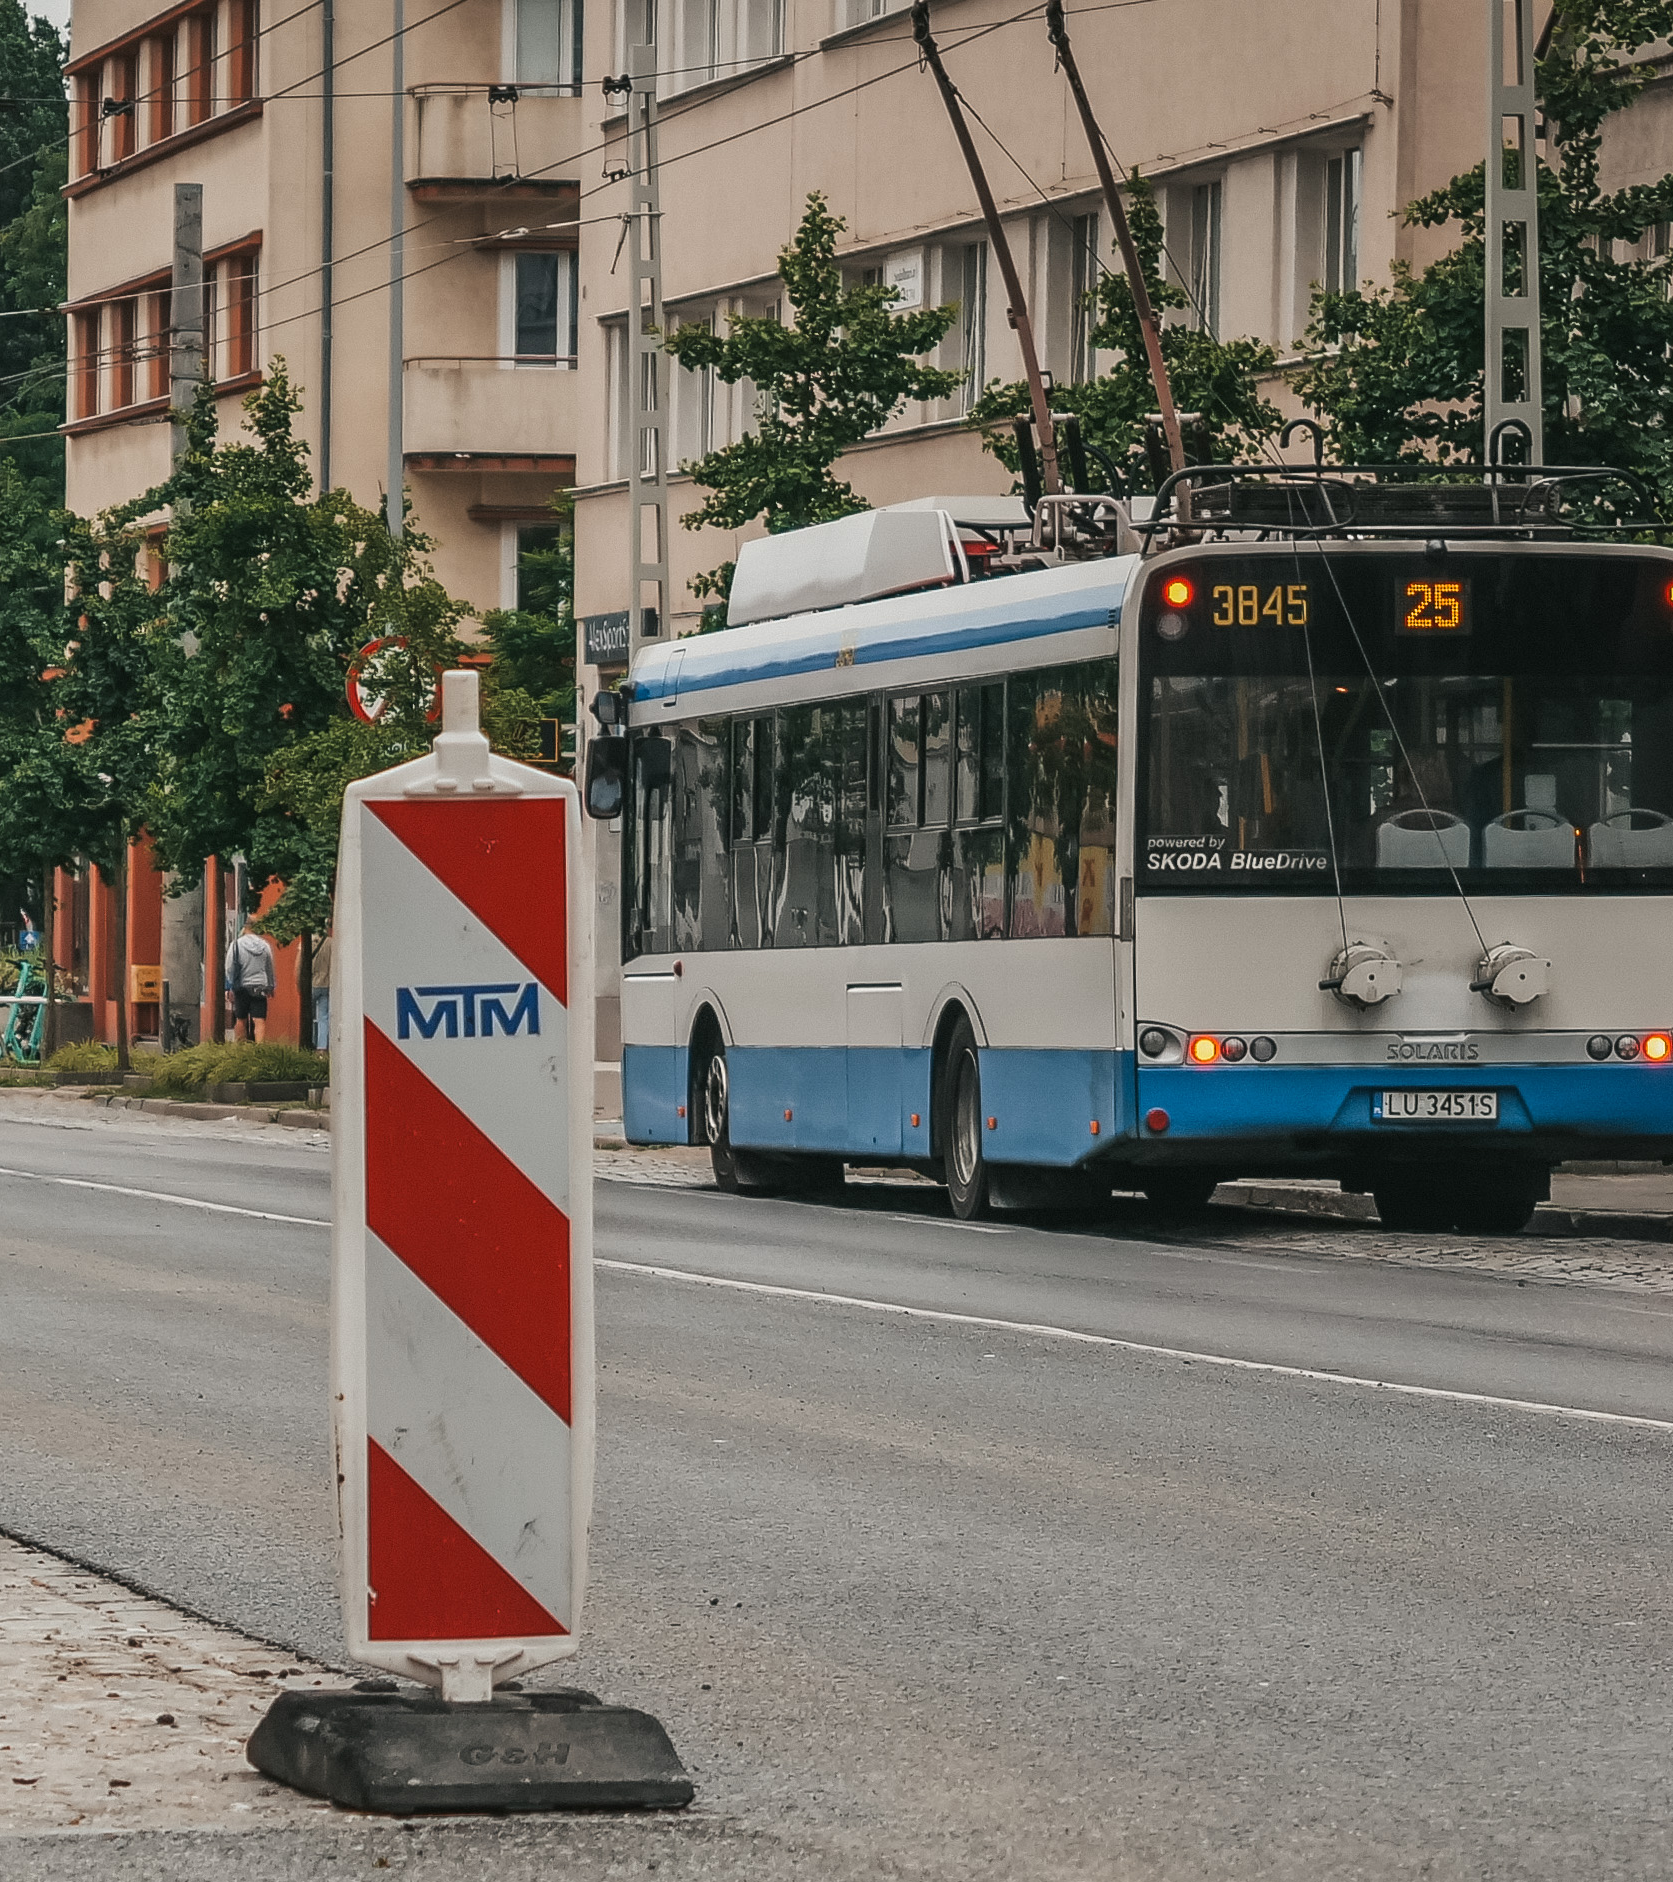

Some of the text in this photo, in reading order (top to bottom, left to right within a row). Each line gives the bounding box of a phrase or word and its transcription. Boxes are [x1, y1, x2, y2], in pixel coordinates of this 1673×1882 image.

[1213, 585, 1307, 626] 3845
[1406, 583, 1460, 628] 25
[1147, 836, 1226, 850] powered by
[1147, 852, 1328, 870] SKODA BlueDrive
[397, 982, 539, 1040] MTM
[1386, 1043, 1479, 1060] SOLARIS
[1388, 1094, 1493, 1116] LU 3451S
